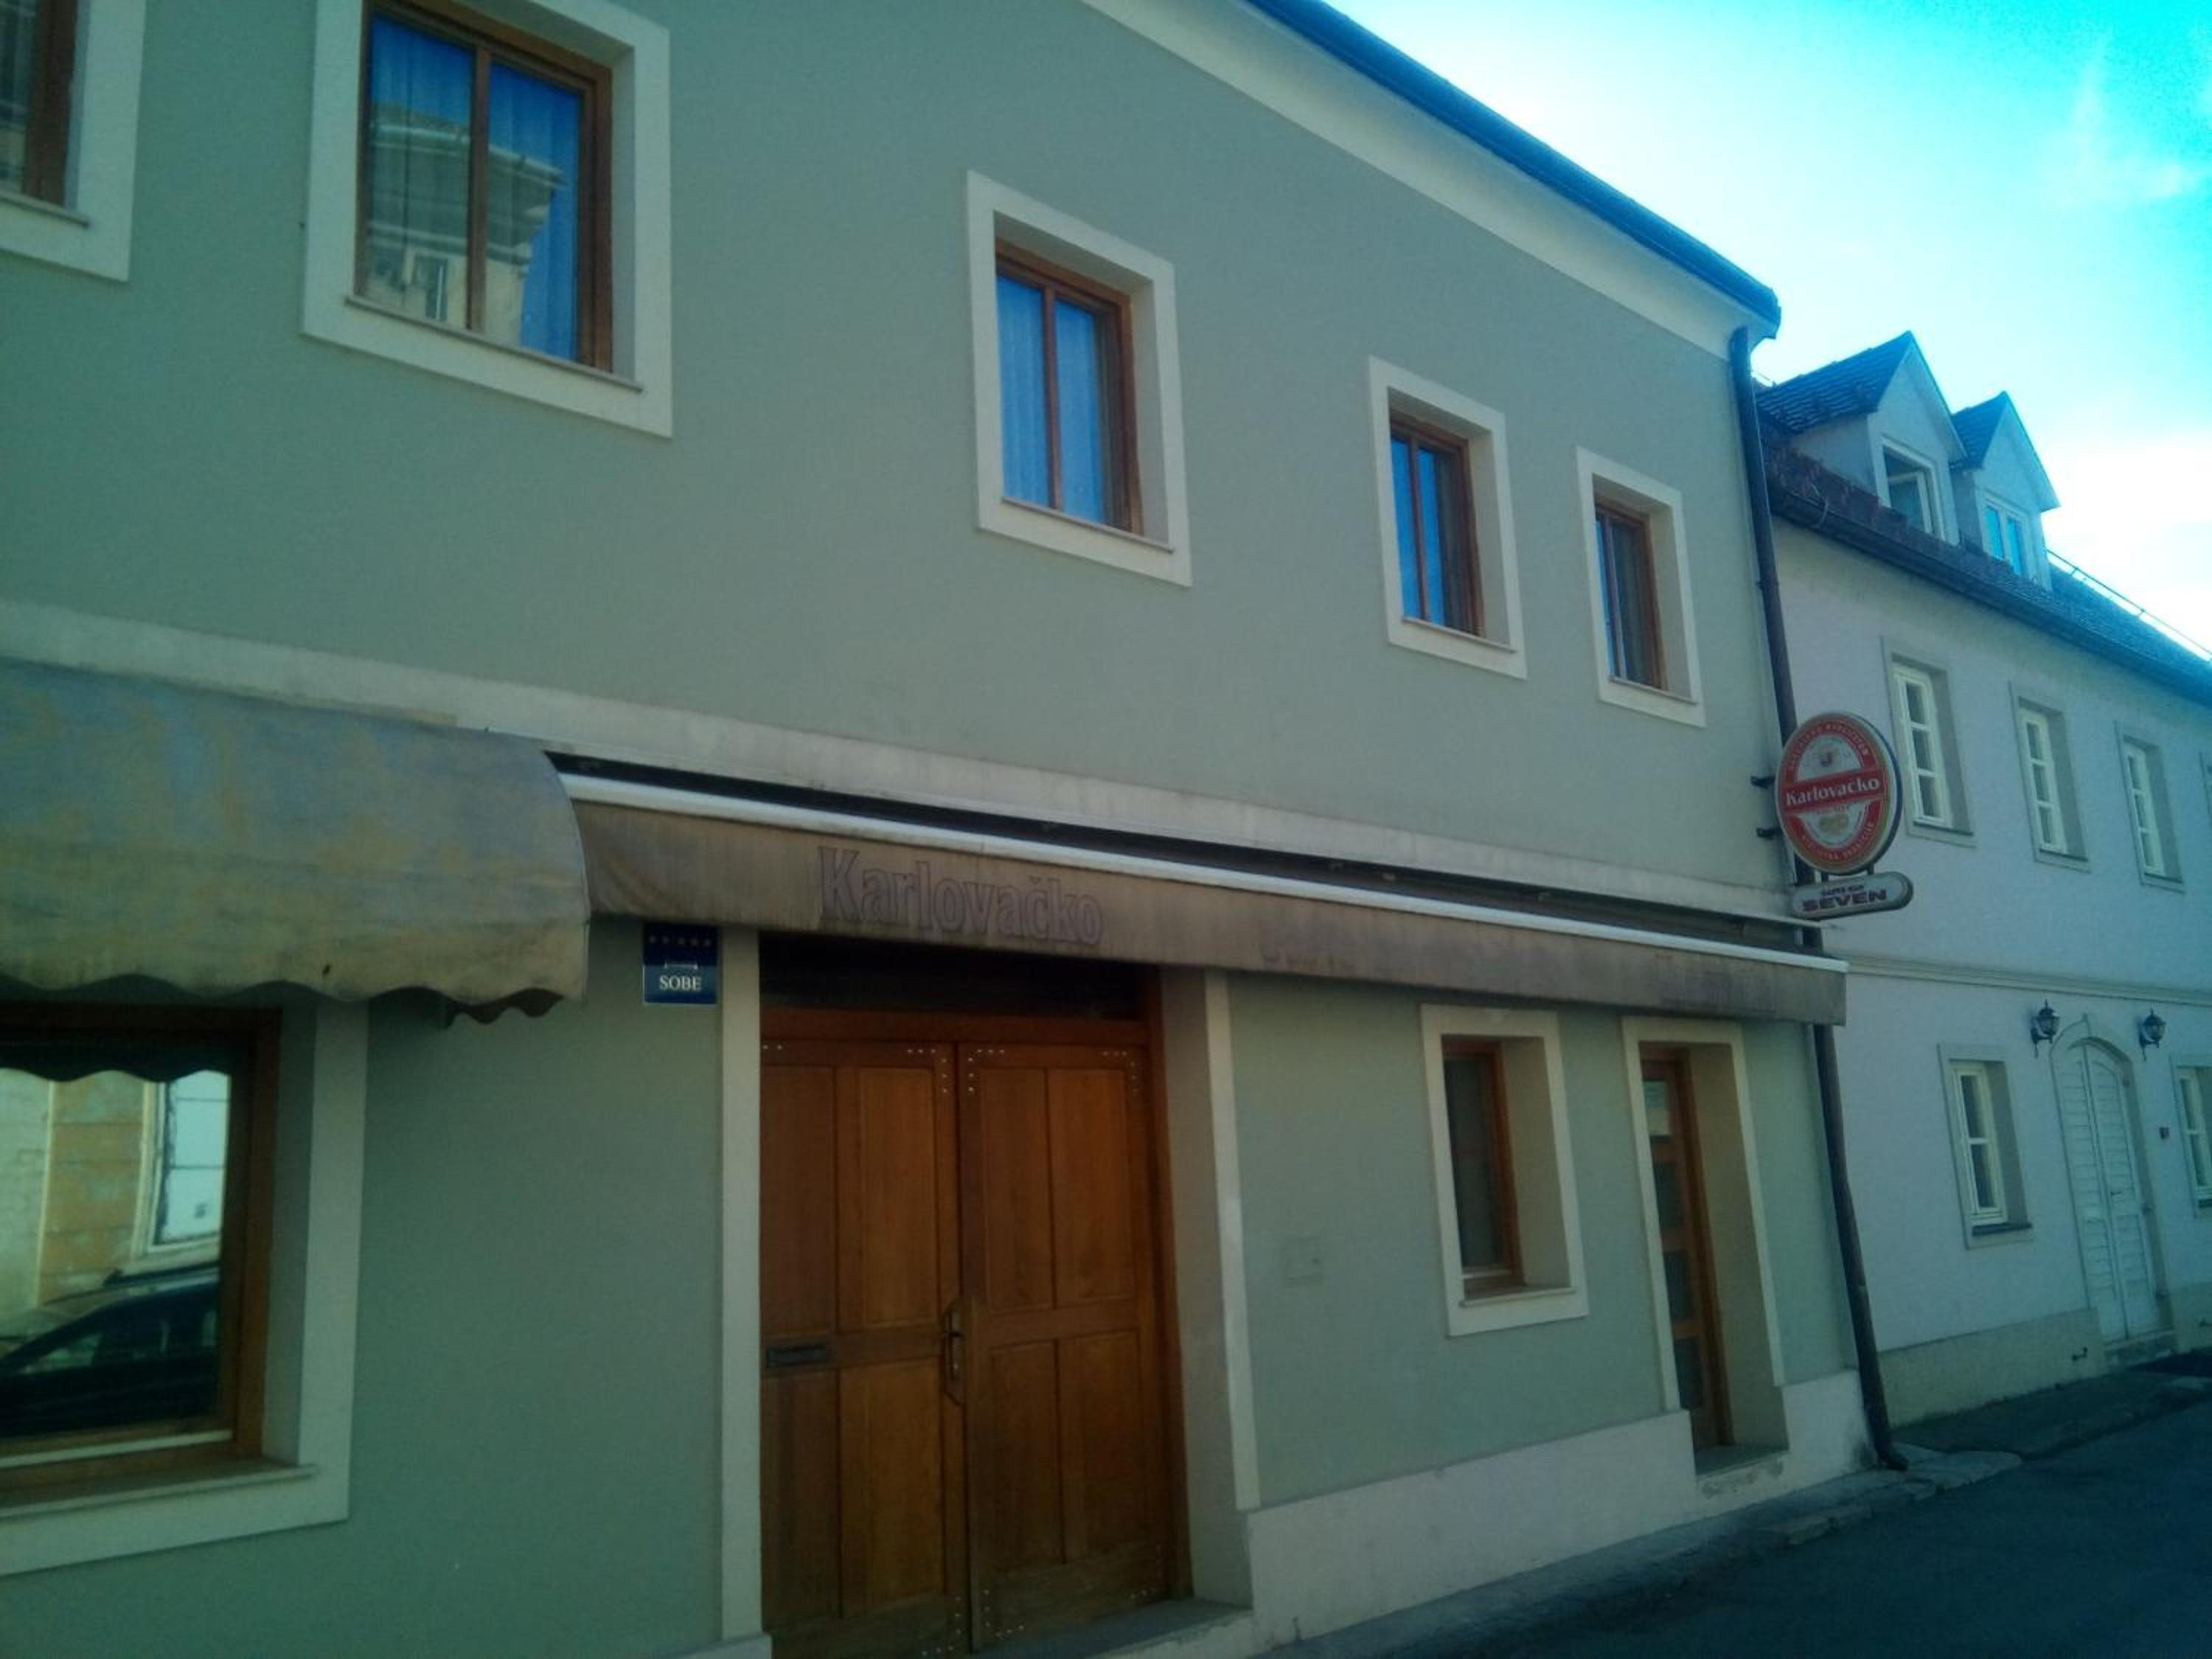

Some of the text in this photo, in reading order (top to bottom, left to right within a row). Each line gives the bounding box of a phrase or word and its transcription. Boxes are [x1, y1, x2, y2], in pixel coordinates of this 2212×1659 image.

[817, 845, 1104, 945] Karlovačko
[1803, 888, 1888, 911] SEVEN
[660, 974, 702, 991] SOBE
